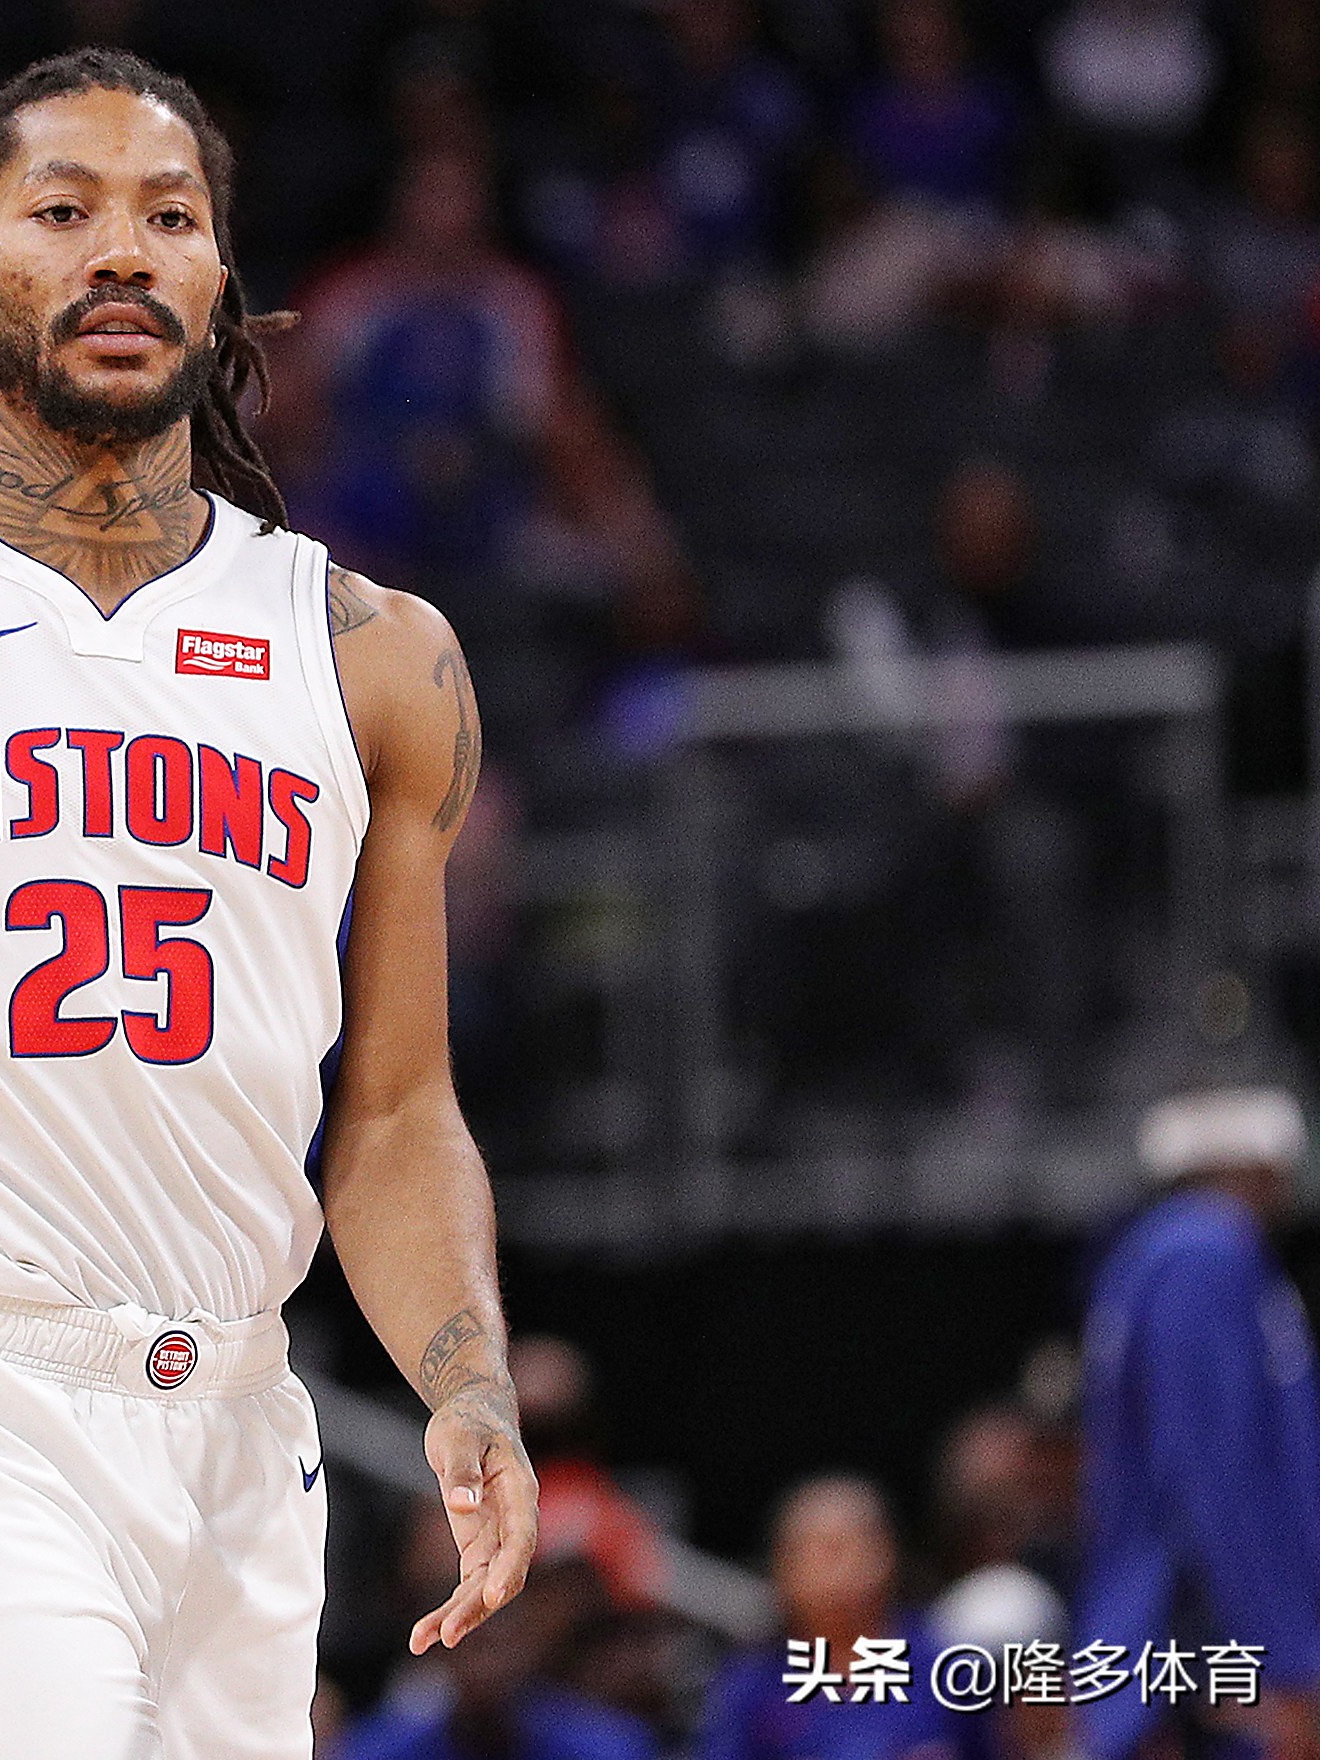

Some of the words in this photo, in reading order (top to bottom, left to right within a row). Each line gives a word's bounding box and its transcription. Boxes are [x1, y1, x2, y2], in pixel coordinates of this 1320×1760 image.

[182, 635, 266, 661] Flagstar
[234, 661, 265, 675] Bank
[5, 878, 215, 1066] 25
